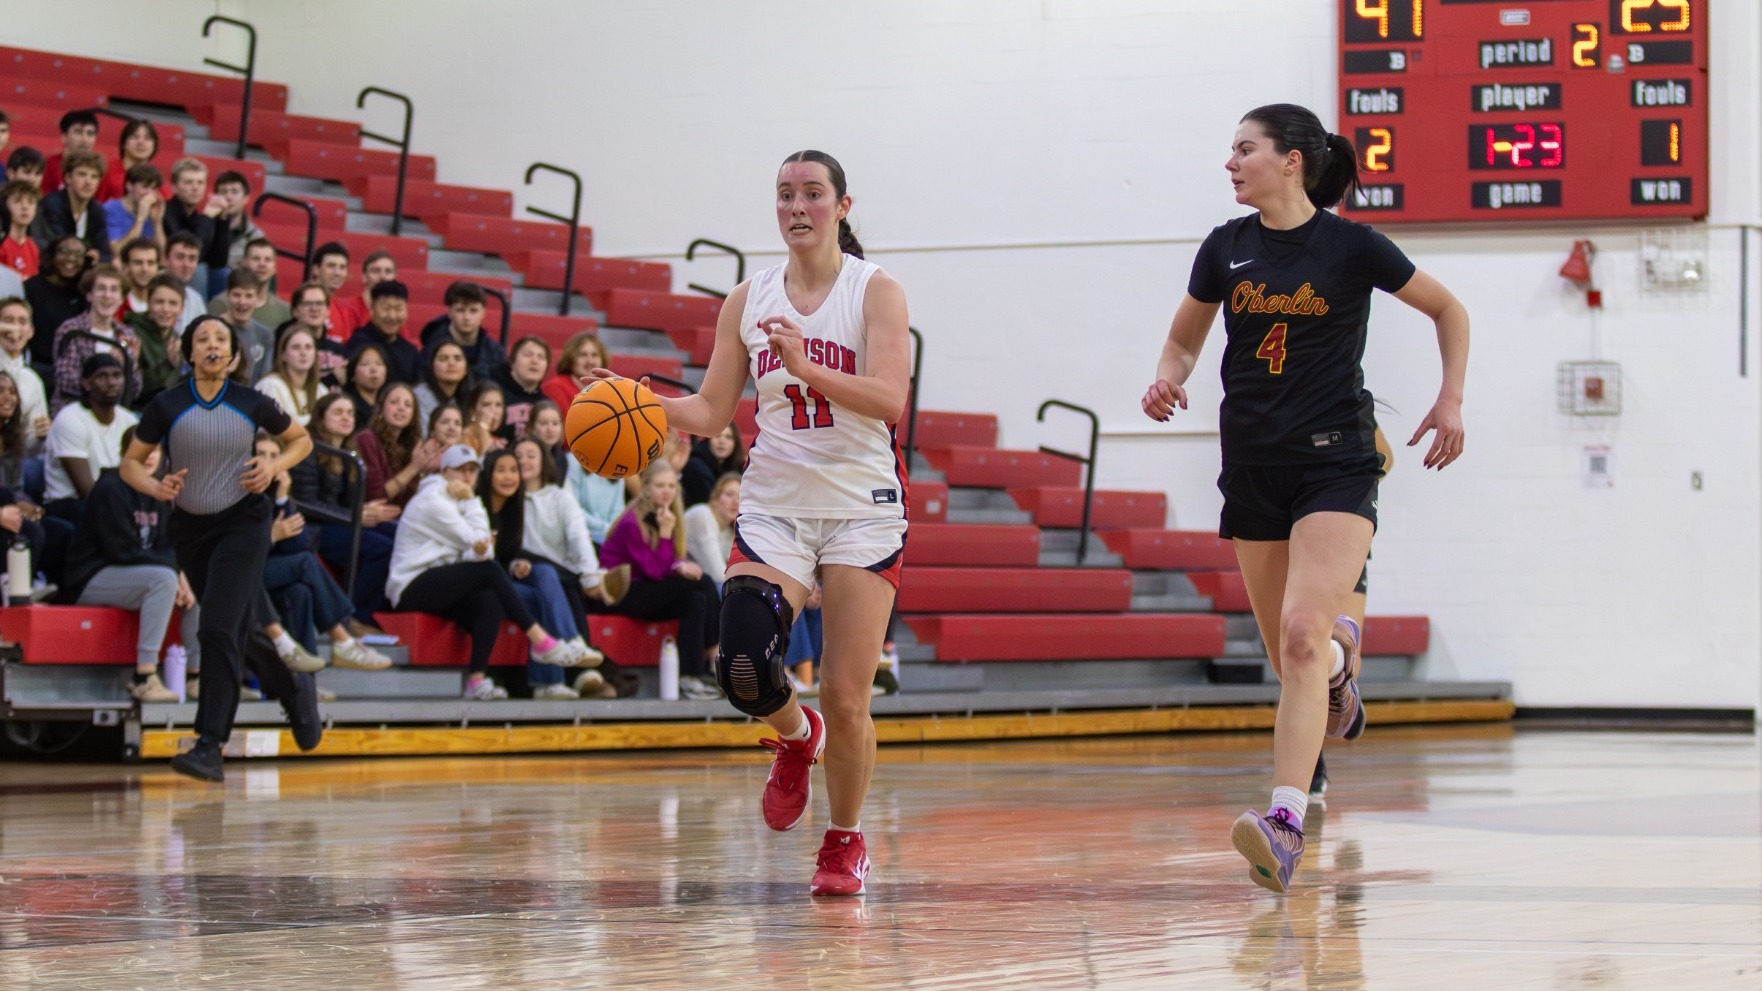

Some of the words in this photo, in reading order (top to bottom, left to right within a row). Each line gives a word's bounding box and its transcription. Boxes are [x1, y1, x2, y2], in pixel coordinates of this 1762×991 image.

[1481, 37, 1551, 69] period
[1573, 23, 1598, 67] 2
[1350, 88, 1399, 114] fouls
[1481, 83, 1550, 112] player
[1635, 80, 1687, 106] fouls
[1366, 128, 1392, 171] 2
[1669, 122, 1679, 163] 1
[1489, 182, 1542, 209] game
[1640, 180, 1682, 201] won
[1231, 281, 1329, 316] Oberlin
[1256, 322, 1288, 374] 4
[783, 384, 834, 430] 11
